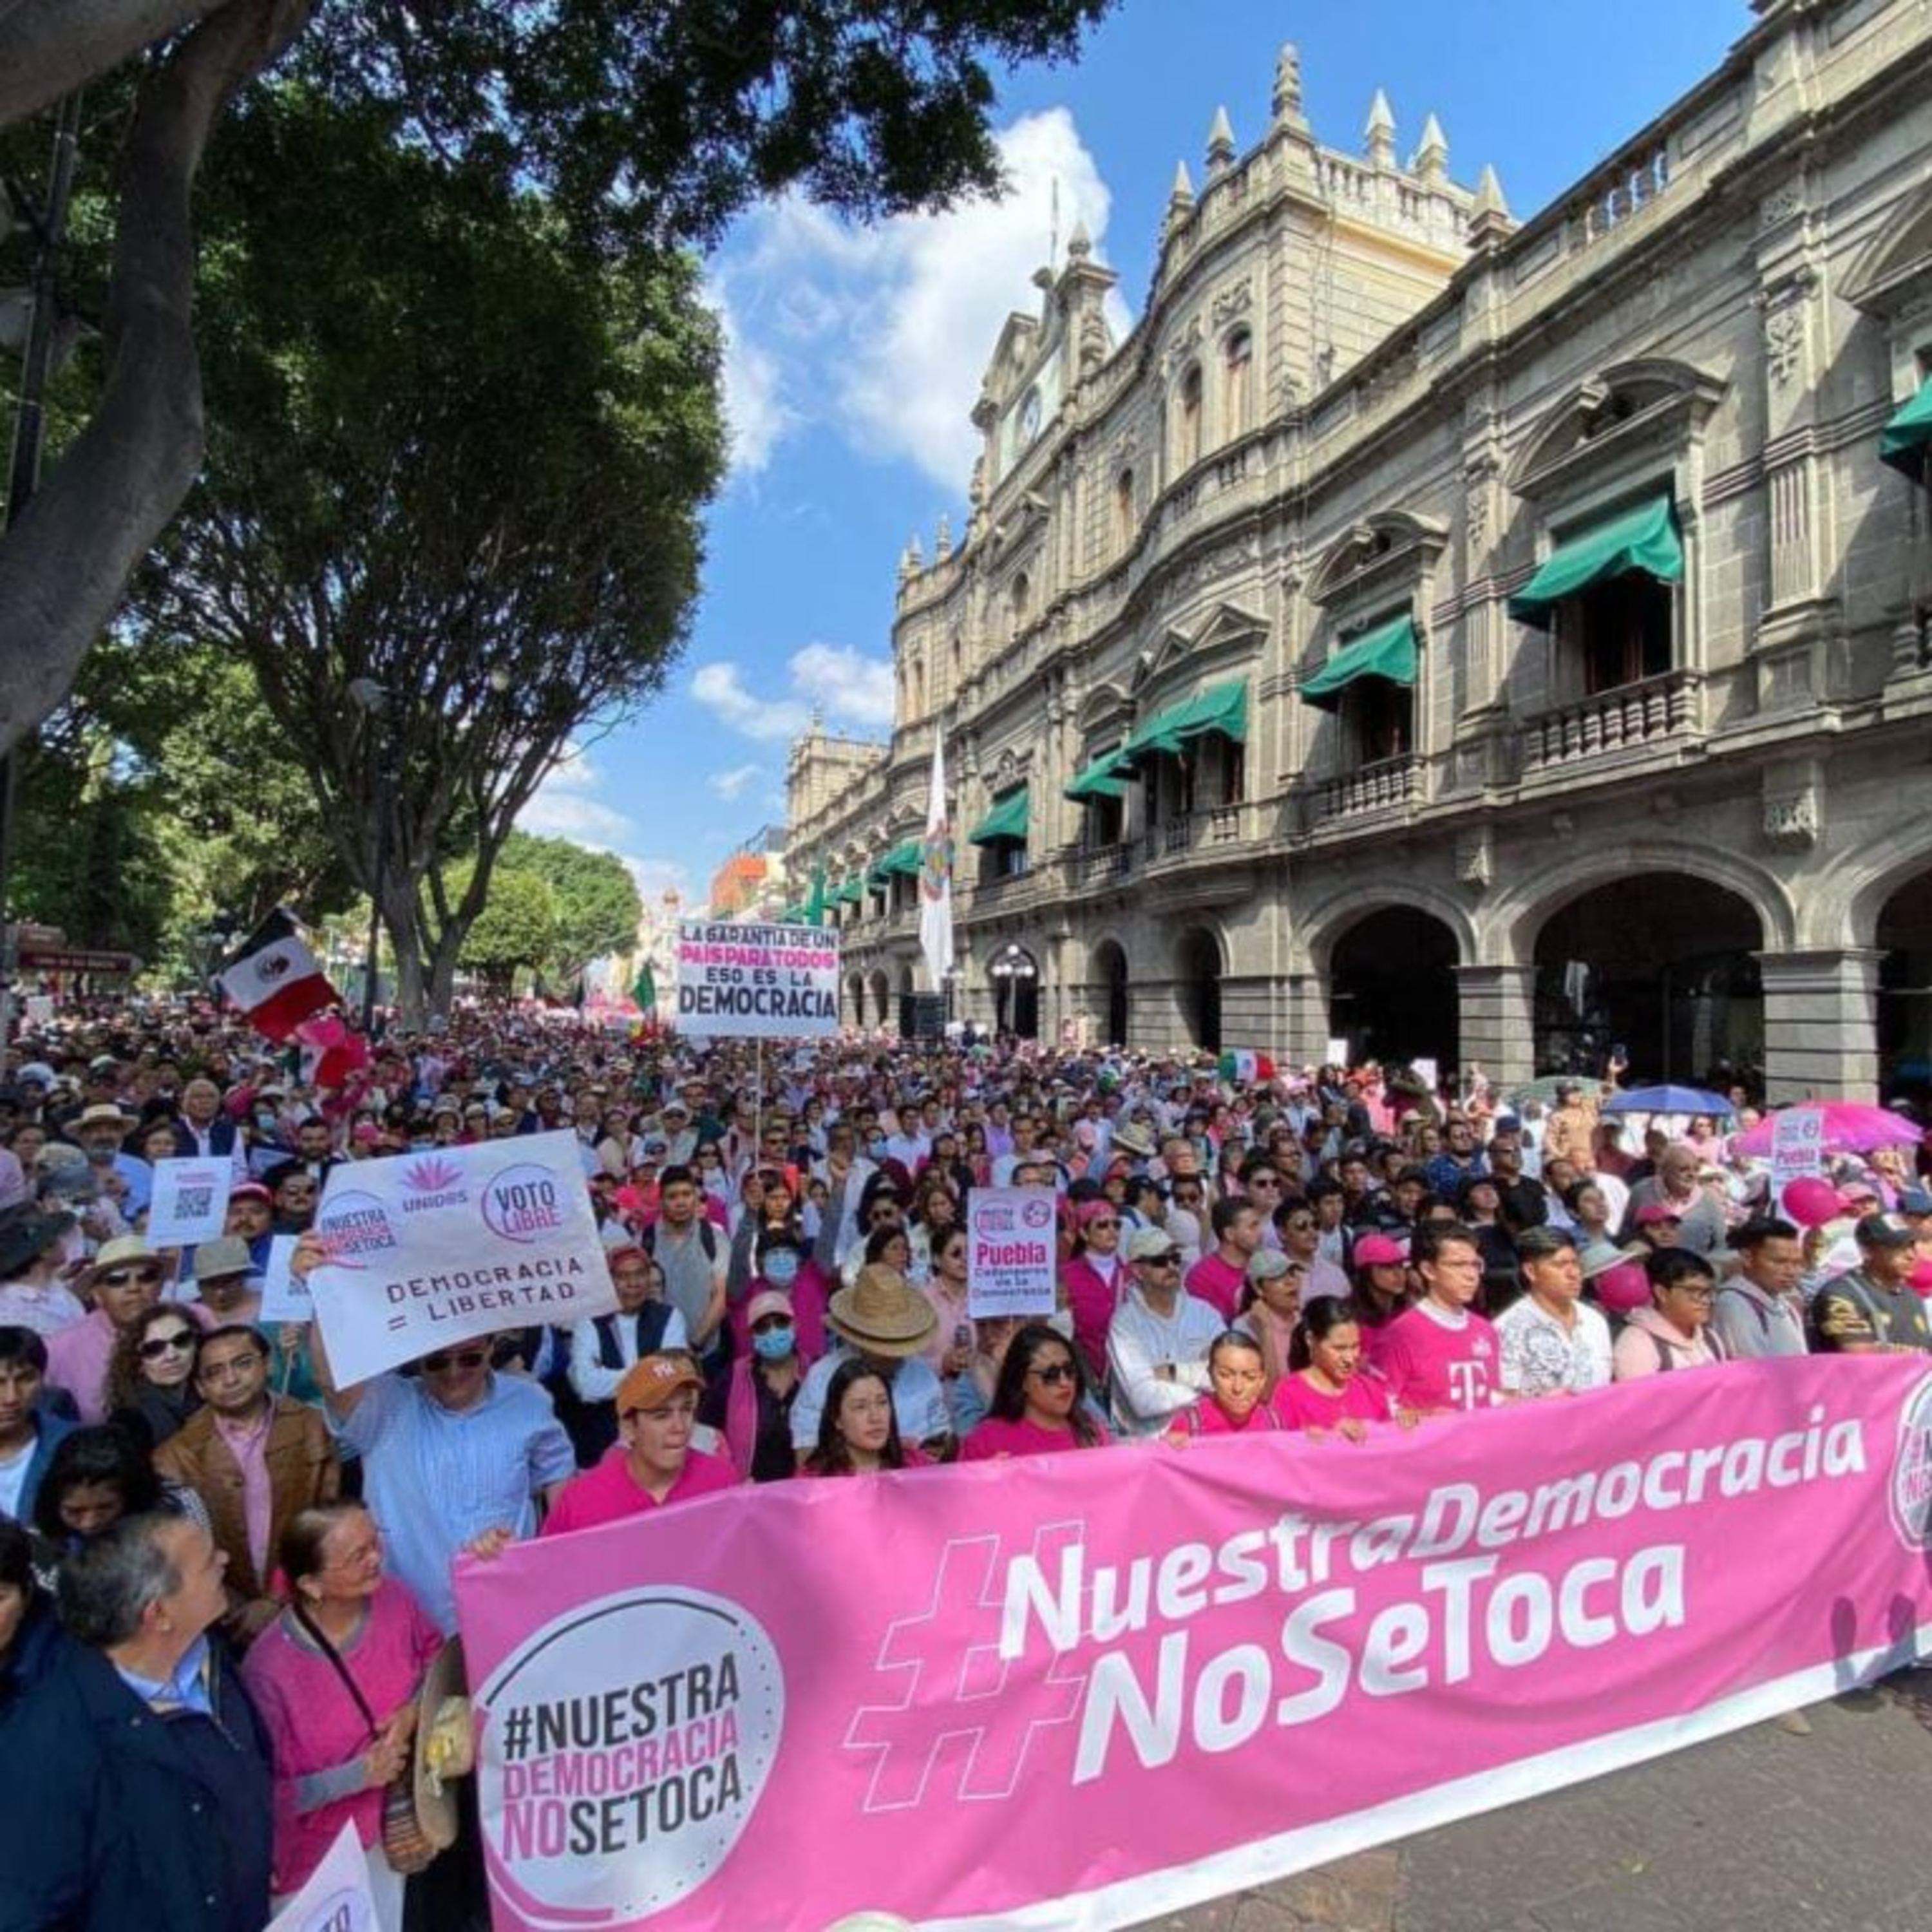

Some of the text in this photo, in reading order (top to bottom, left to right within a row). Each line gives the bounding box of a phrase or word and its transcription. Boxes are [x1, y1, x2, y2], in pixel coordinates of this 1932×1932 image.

[681, 925, 703, 942] LA
[790, 931, 811, 948] DE
[813, 934, 836, 949] UN
[706, 967, 812, 986] ESO ES LA
[679, 985, 836, 1018] DEMOCRACIA
[495, 1180, 555, 1211] VOTO
[502, 1206, 562, 1233] LIBRE
[976, 1242, 1046, 1266] Puebla
[386, 1257, 584, 1303] DEMOCRACIA
[427, 1282, 575, 1321] LIBERTAD
[1072, 1545, 1685, 1786] NoSeToca
[504, 1651, 740, 1760] #NUESTRA
[503, 1708, 739, 1800] DEMOCRACIA
[502, 1752, 742, 1861] NOSETOCA
